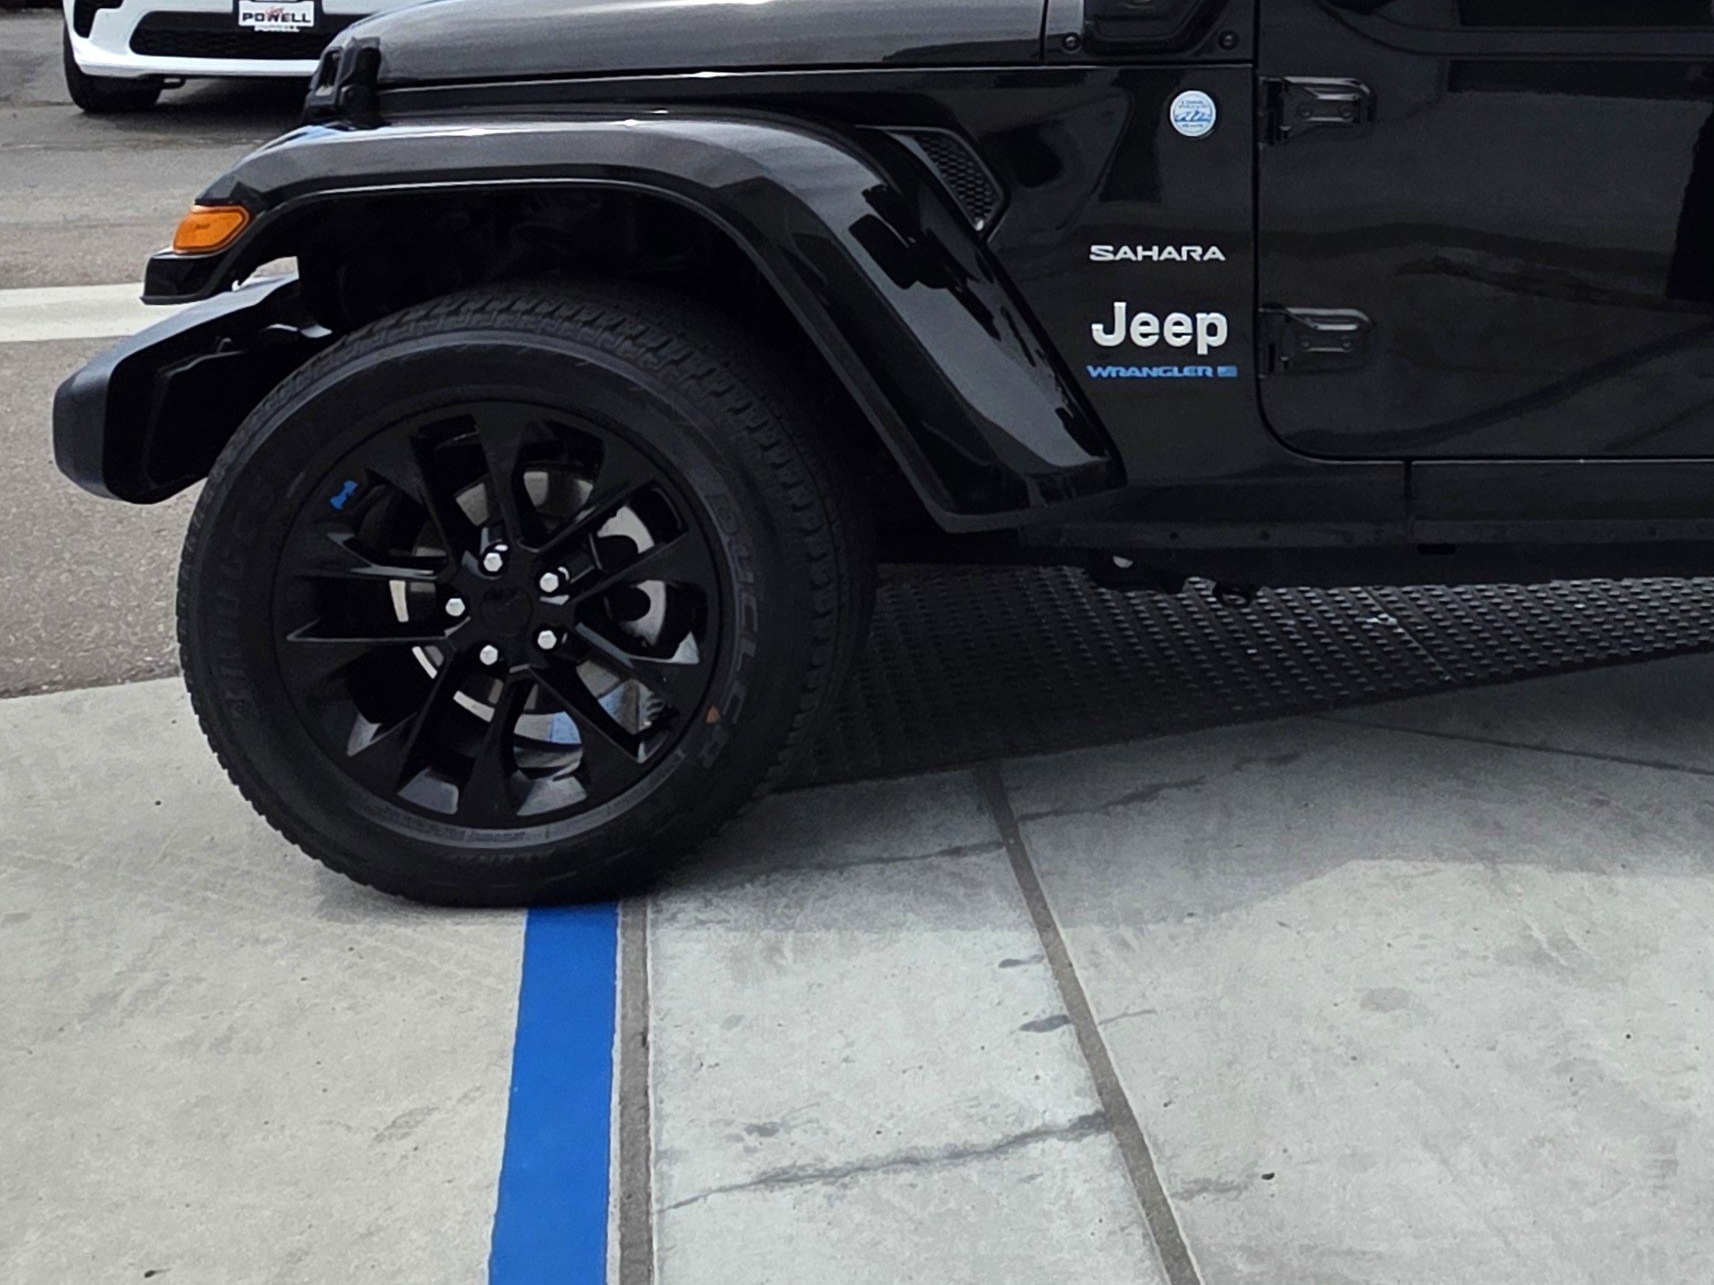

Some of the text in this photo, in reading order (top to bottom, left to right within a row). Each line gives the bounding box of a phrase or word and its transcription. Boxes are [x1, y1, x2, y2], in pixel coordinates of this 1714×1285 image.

[242, 12, 311, 23] POWELL
[1089, 245, 1226, 261] SAHARA
[1091, 301, 1229, 355] Jeep
[1086, 365, 1213, 378] WRANGLER
